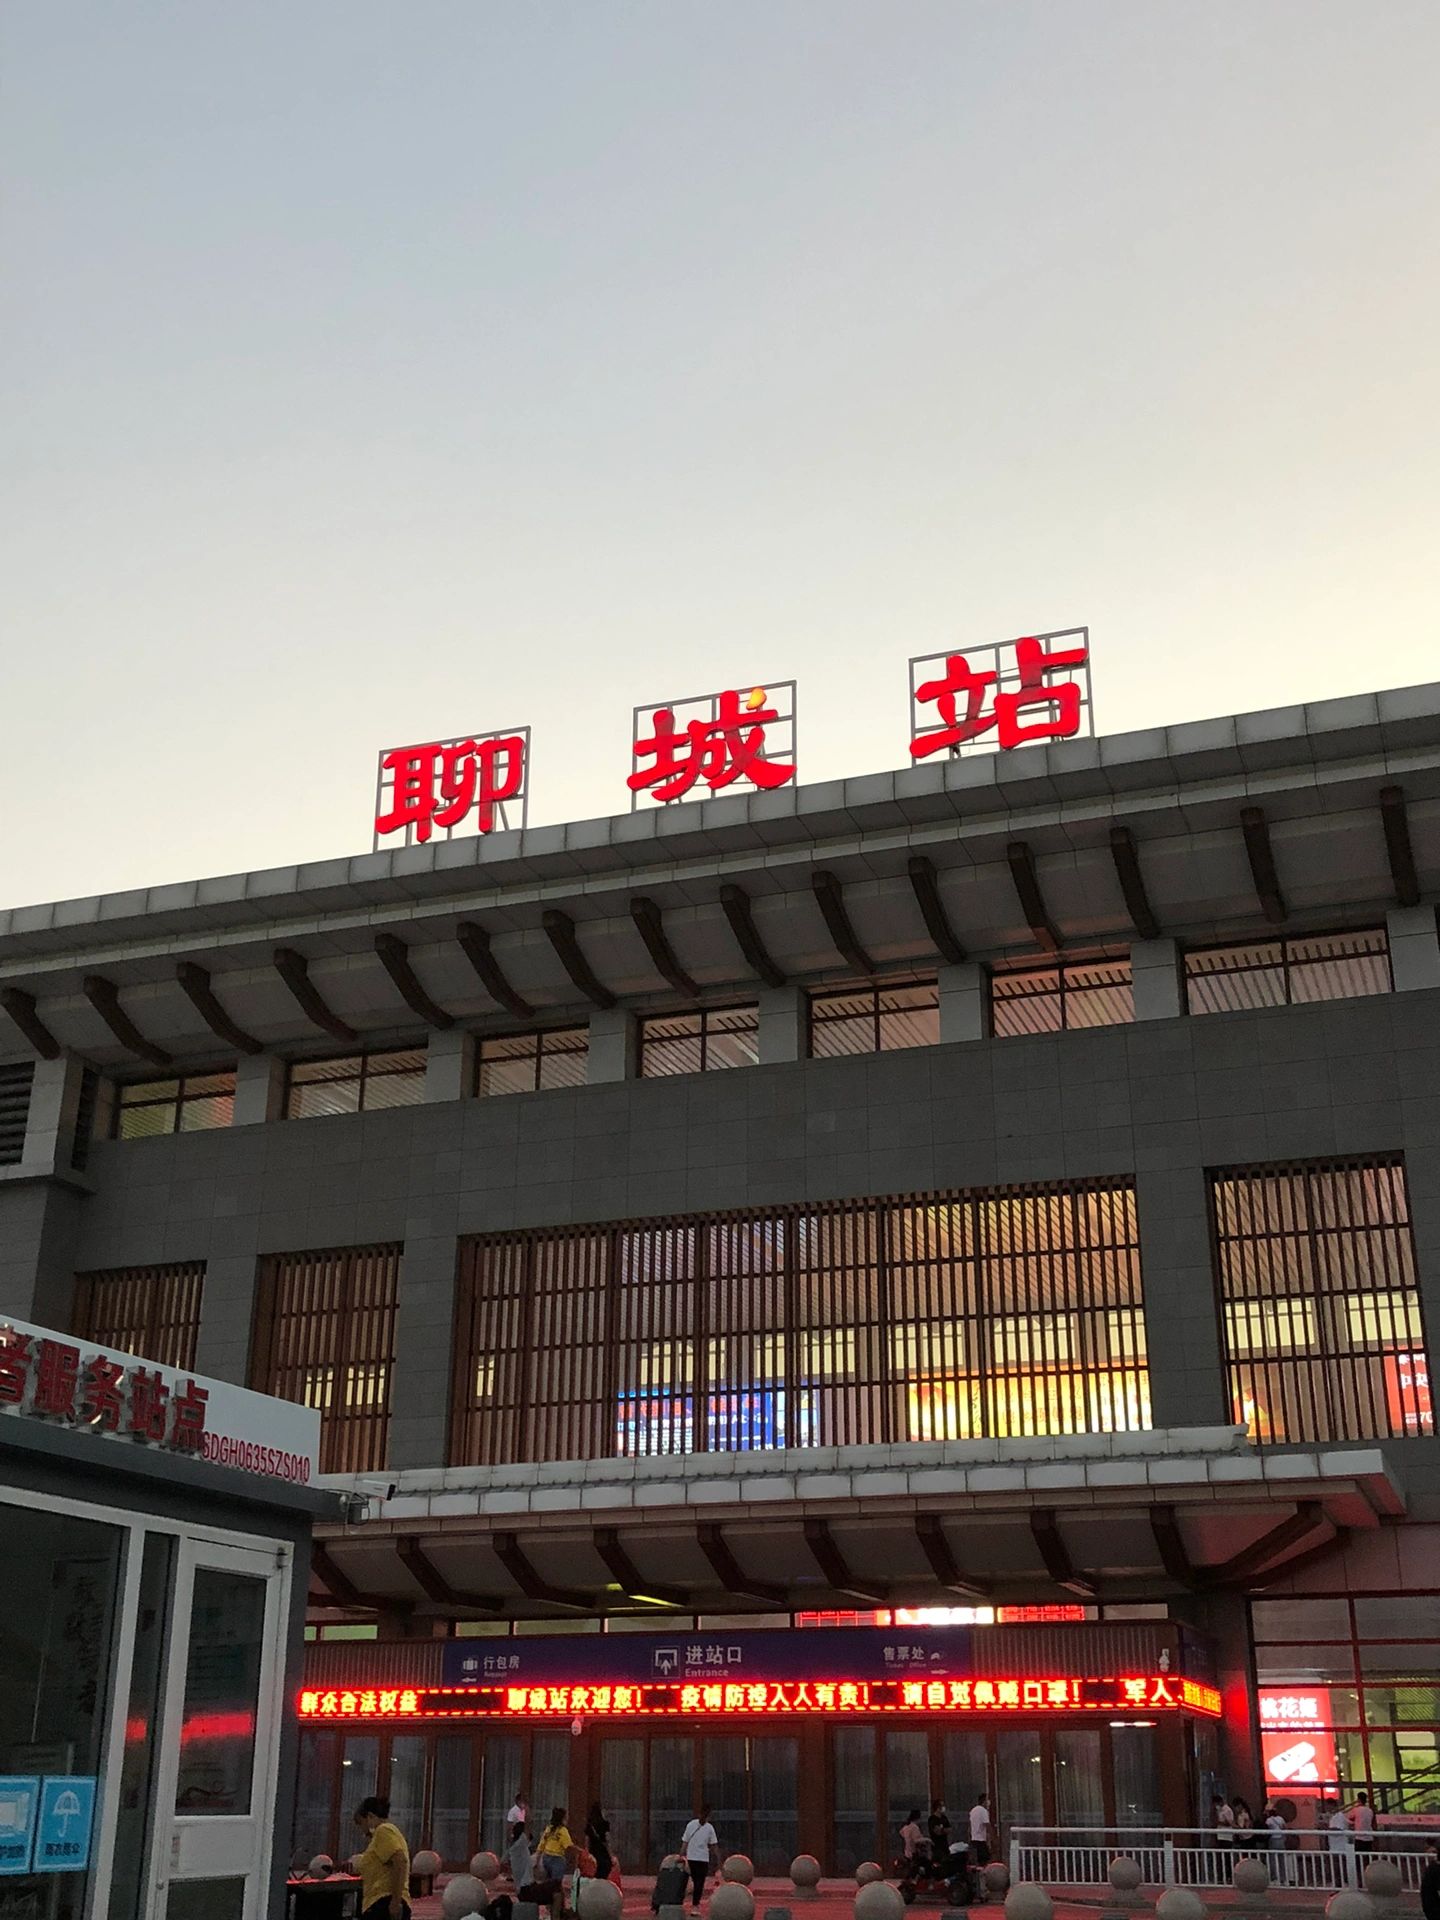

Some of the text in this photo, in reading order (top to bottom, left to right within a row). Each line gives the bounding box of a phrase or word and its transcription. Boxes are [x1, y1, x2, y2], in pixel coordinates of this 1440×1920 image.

[376, 637, 1088, 843] 聊城站
[202, 1431, 311, 1483] SDGH0635SZS010
[483, 1655, 520, 1670] 行包房
[685, 1645, 743, 1666] 进站口
[883, 1646, 925, 1661] 售票处
[684, 1667, 729, 1678] Entrance
[301, 1691, 418, 1713] 群众合法权益
